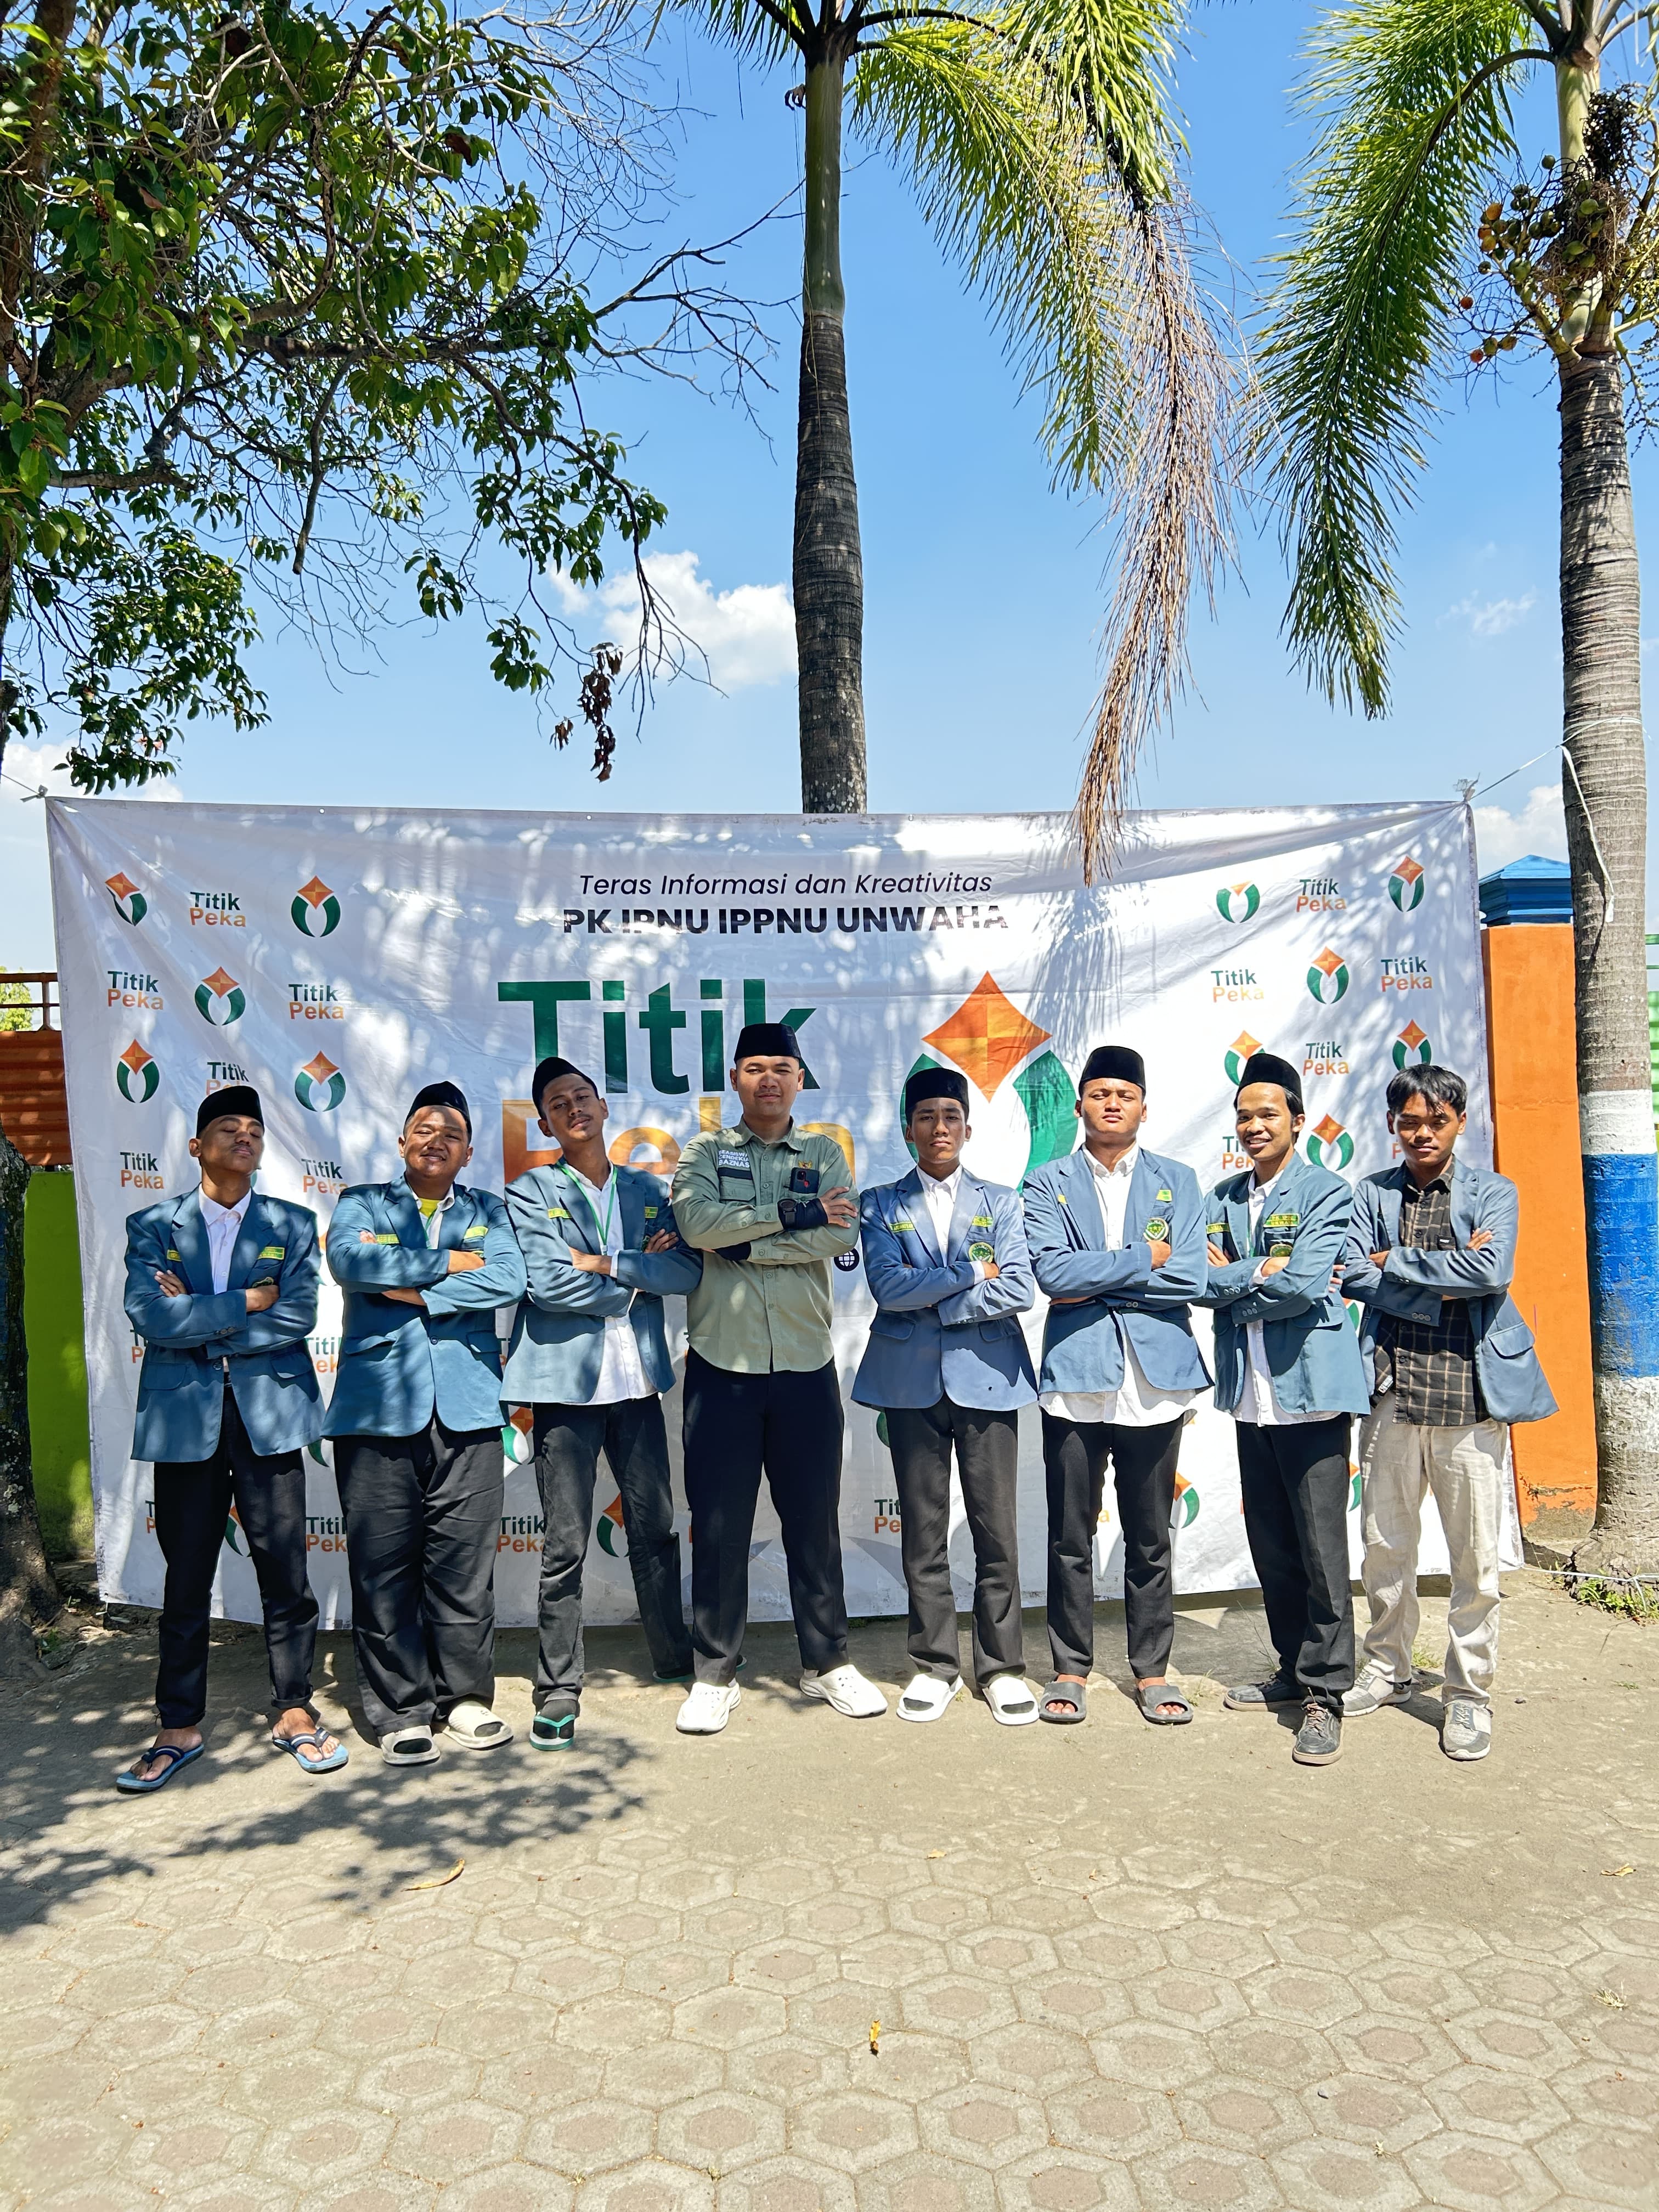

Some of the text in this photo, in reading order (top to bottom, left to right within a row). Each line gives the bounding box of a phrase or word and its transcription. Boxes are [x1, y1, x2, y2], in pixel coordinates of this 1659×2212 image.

[580, 872, 992, 895] Teras Informasi dan Kreativitas
[1298, 878, 1339, 896] Titik
[190, 891, 240, 911] Titik
[1296, 895, 1347, 912] Peka
[189, 908, 246, 927] Peka
[563, 909, 612, 934] PK
[719, 908, 827, 934] IPPNU
[837, 905, 1008, 933] UNWAHA
[1381, 956, 1427, 976] Titik
[108, 970, 159, 992] Titik
[1210, 969, 1257, 986] Titik
[1381, 974, 1434, 992] Peka
[107, 989, 164, 1011] Peka
[288, 984, 338, 1002] Titik
[1212, 986, 1265, 1003] Peka
[290, 1002, 345, 1020] Peka
[498, 978, 821, 1094] Titik
[1306, 1041, 1343, 1059] Titik
[207, 1062, 250, 1082] Titik
[1302, 1058, 1350, 1076] Peka
[120, 1152, 159, 1172] Titik
[301, 1158, 343, 1180] Titik
[719, 1159, 750, 1168] BAZNAS
[1222, 1153, 1255, 1170] Pek
[121, 1170, 164, 1189] Peka
[874, 1499, 901, 1516] Tit
[500, 1515, 544, 1534] Titik
[874, 1516, 900, 1534] Pe
[306, 1534, 347, 1552] Pek
